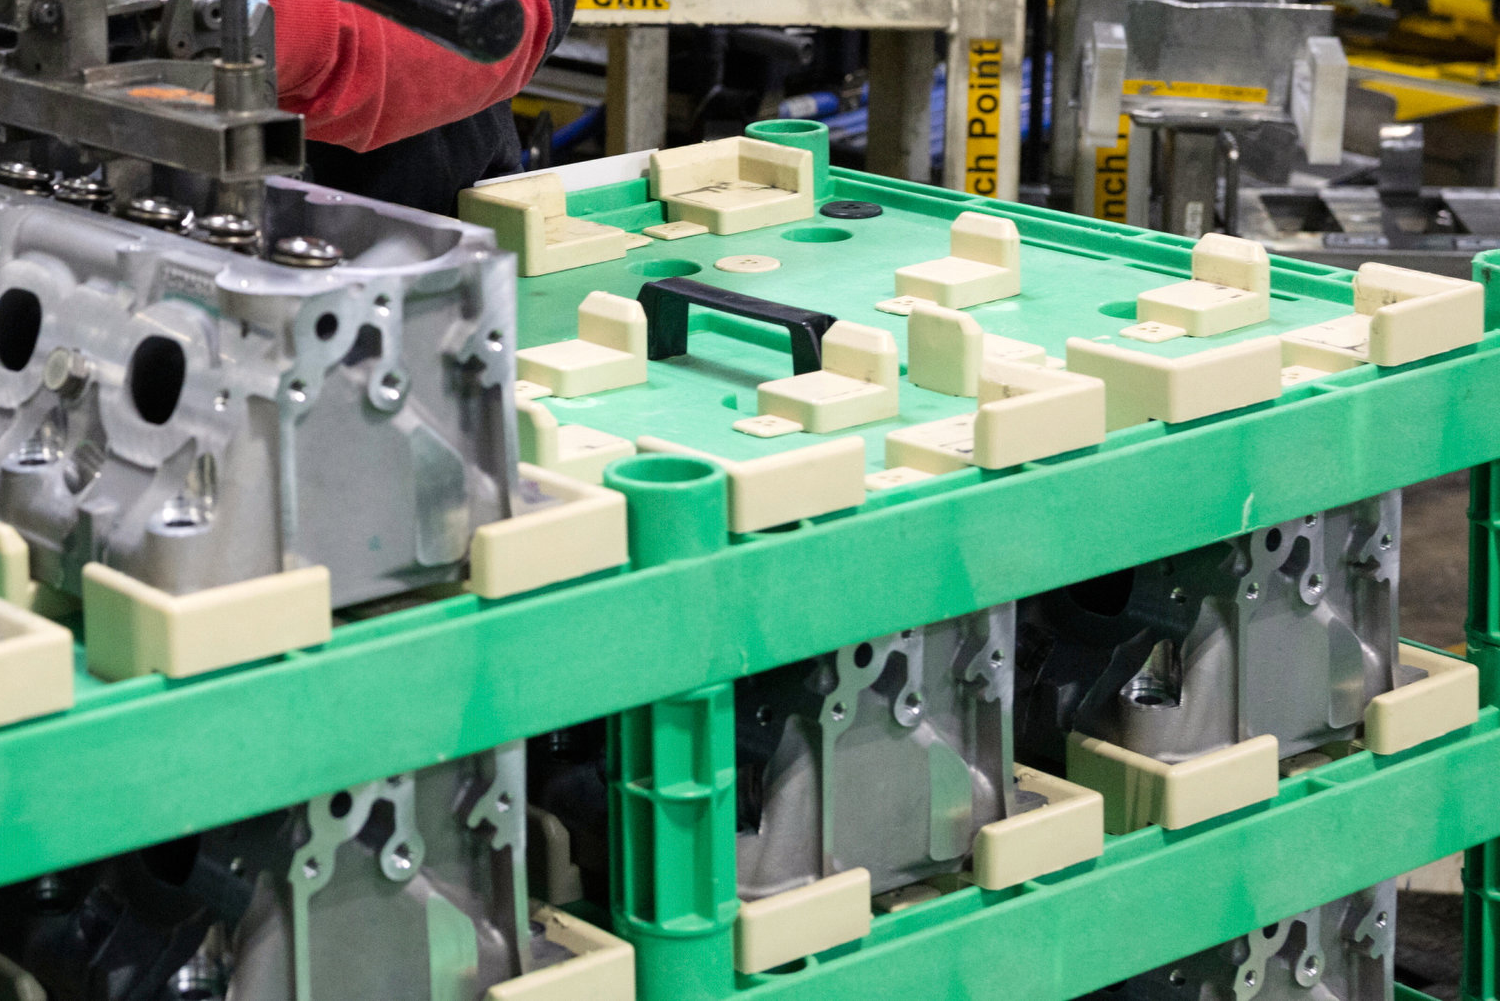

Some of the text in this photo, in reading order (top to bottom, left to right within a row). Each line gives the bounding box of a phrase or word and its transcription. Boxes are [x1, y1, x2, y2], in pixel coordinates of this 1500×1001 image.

[967, 45, 1000, 195] ch Point
[1097, 155, 1127, 218] nch
